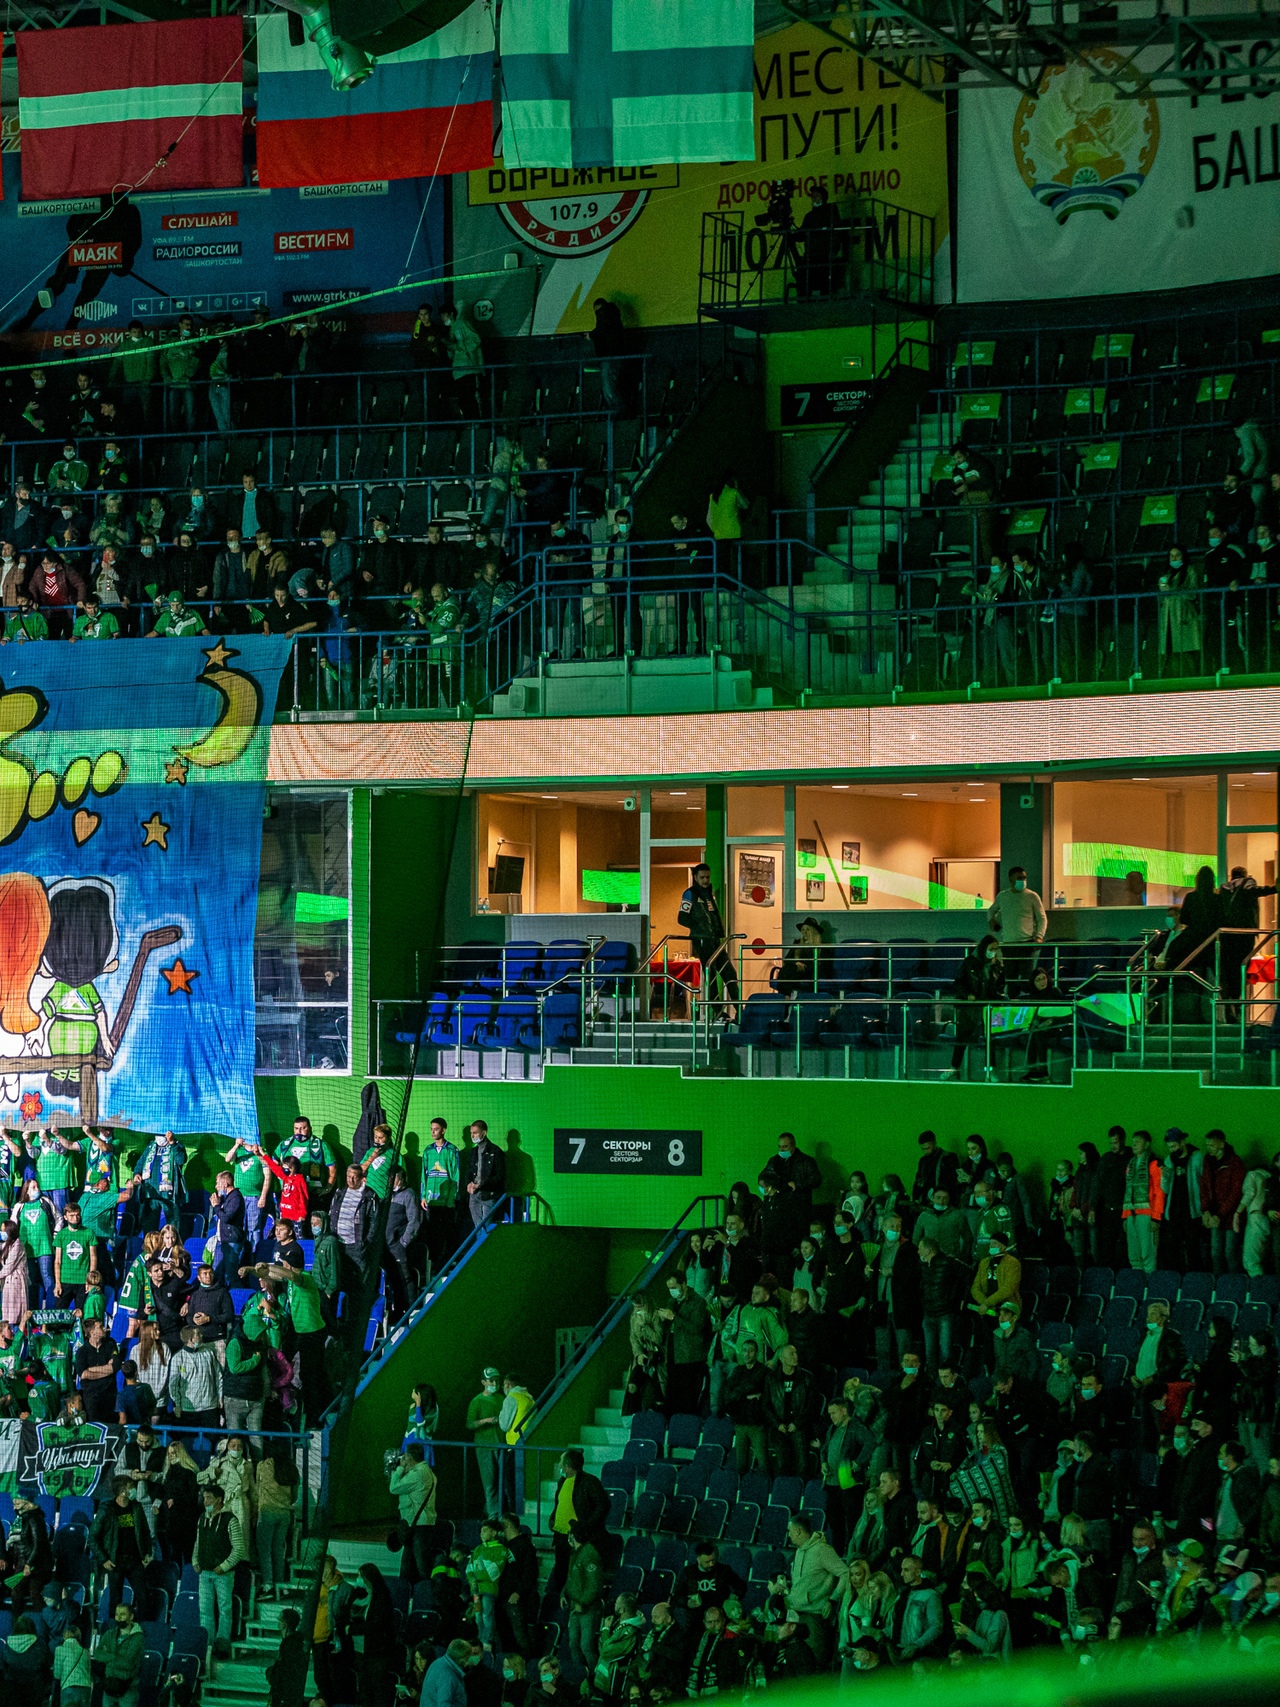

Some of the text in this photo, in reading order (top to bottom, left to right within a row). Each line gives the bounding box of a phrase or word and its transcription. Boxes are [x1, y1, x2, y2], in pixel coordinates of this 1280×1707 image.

[754, 46, 901, 101] МЕСТЕ
[760, 103, 899, 162] ПУТИ!
[304, 182, 383, 197] БАШКОРТОСТАН
[833, 168, 901, 198] РАДИО
[21, 201, 96, 216] БАШКОРТОСТАН
[550, 201, 599, 221] 107.9
[169, 213, 232, 229] СЛУШАЙ!
[526, 211, 621, 246] РАДИО
[73, 246, 118, 262] МАЯК
[292, 290, 360, 303] www.gtrk.tv
[74, 300, 118, 321] СМОТРИМ
[53, 331, 81, 347] ВСЁ
[85, 333, 97, 346] О
[795, 392, 810, 417] 7
[569, 1138, 685, 1166] 7 СЕКТОРЫ 8
